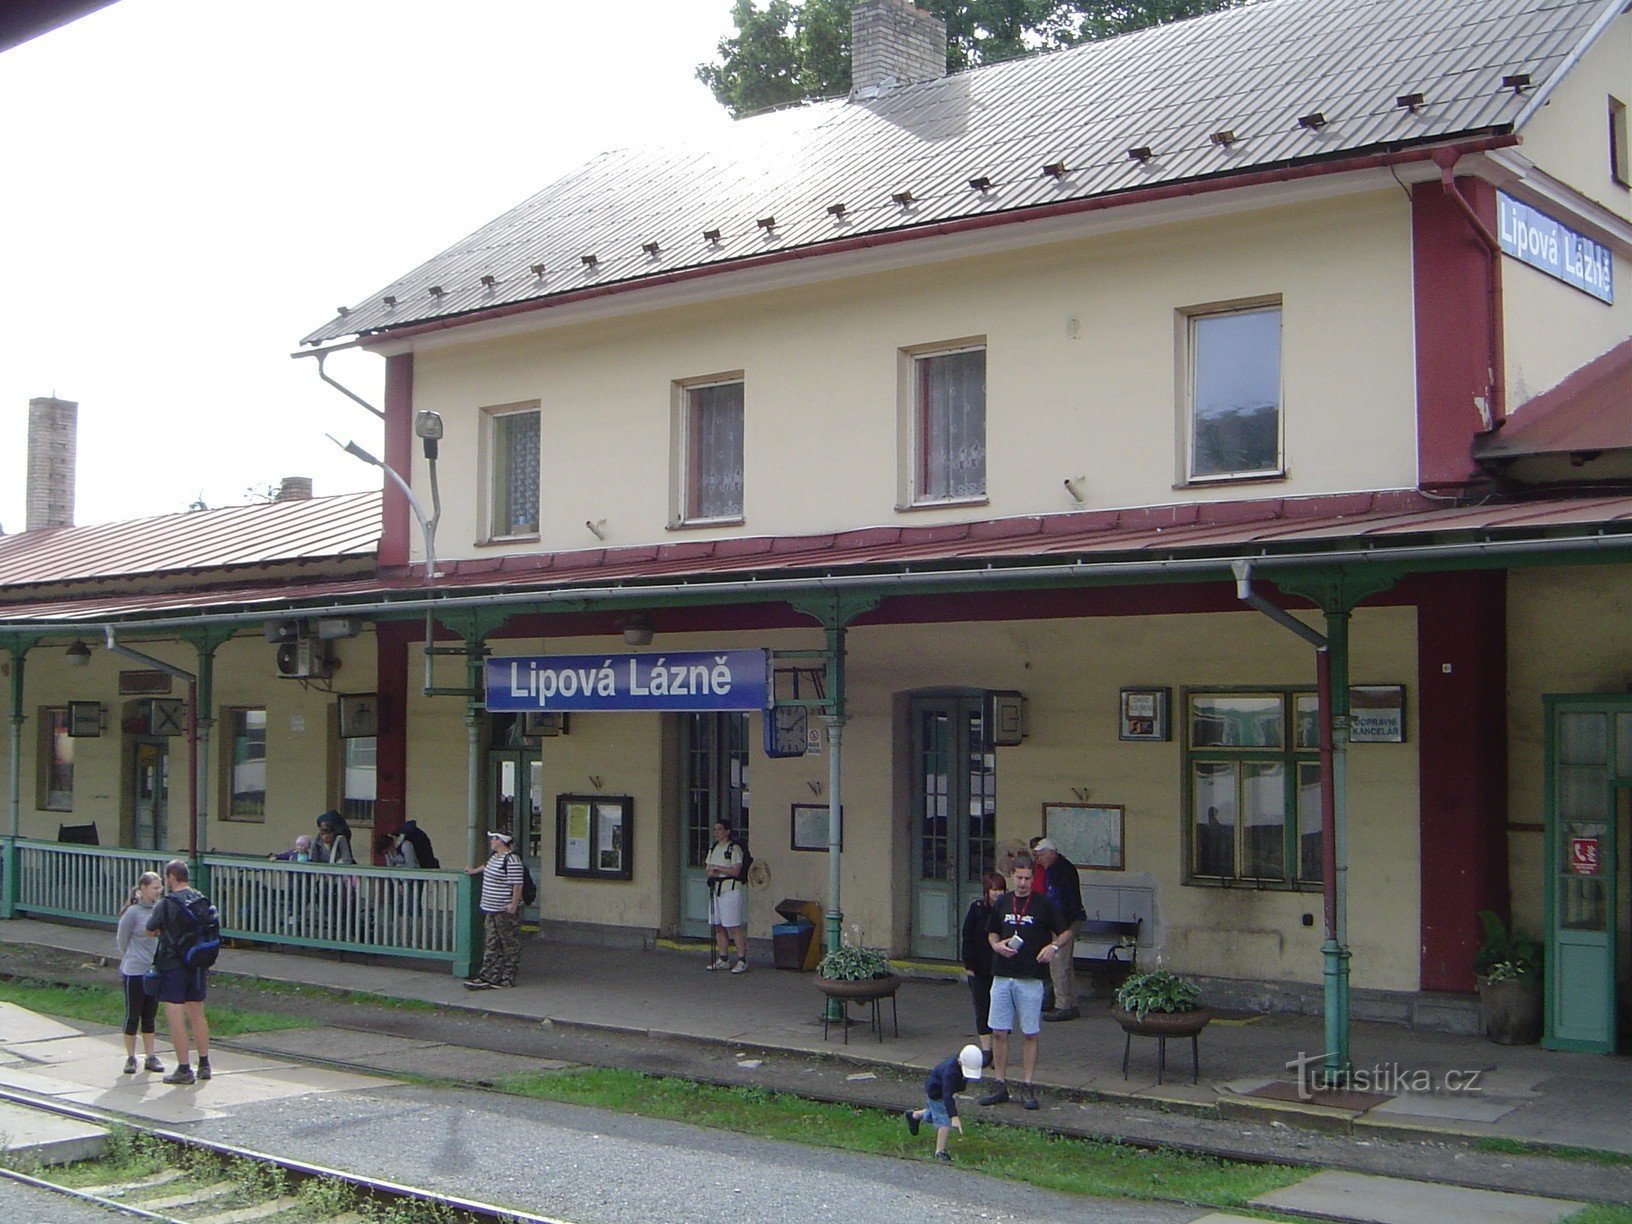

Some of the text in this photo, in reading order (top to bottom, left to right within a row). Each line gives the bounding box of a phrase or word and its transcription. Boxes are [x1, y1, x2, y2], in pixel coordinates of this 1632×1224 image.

[1501, 202, 1610, 293] Lipová Lázně
[510, 656, 732, 707] Lipová Lázně
